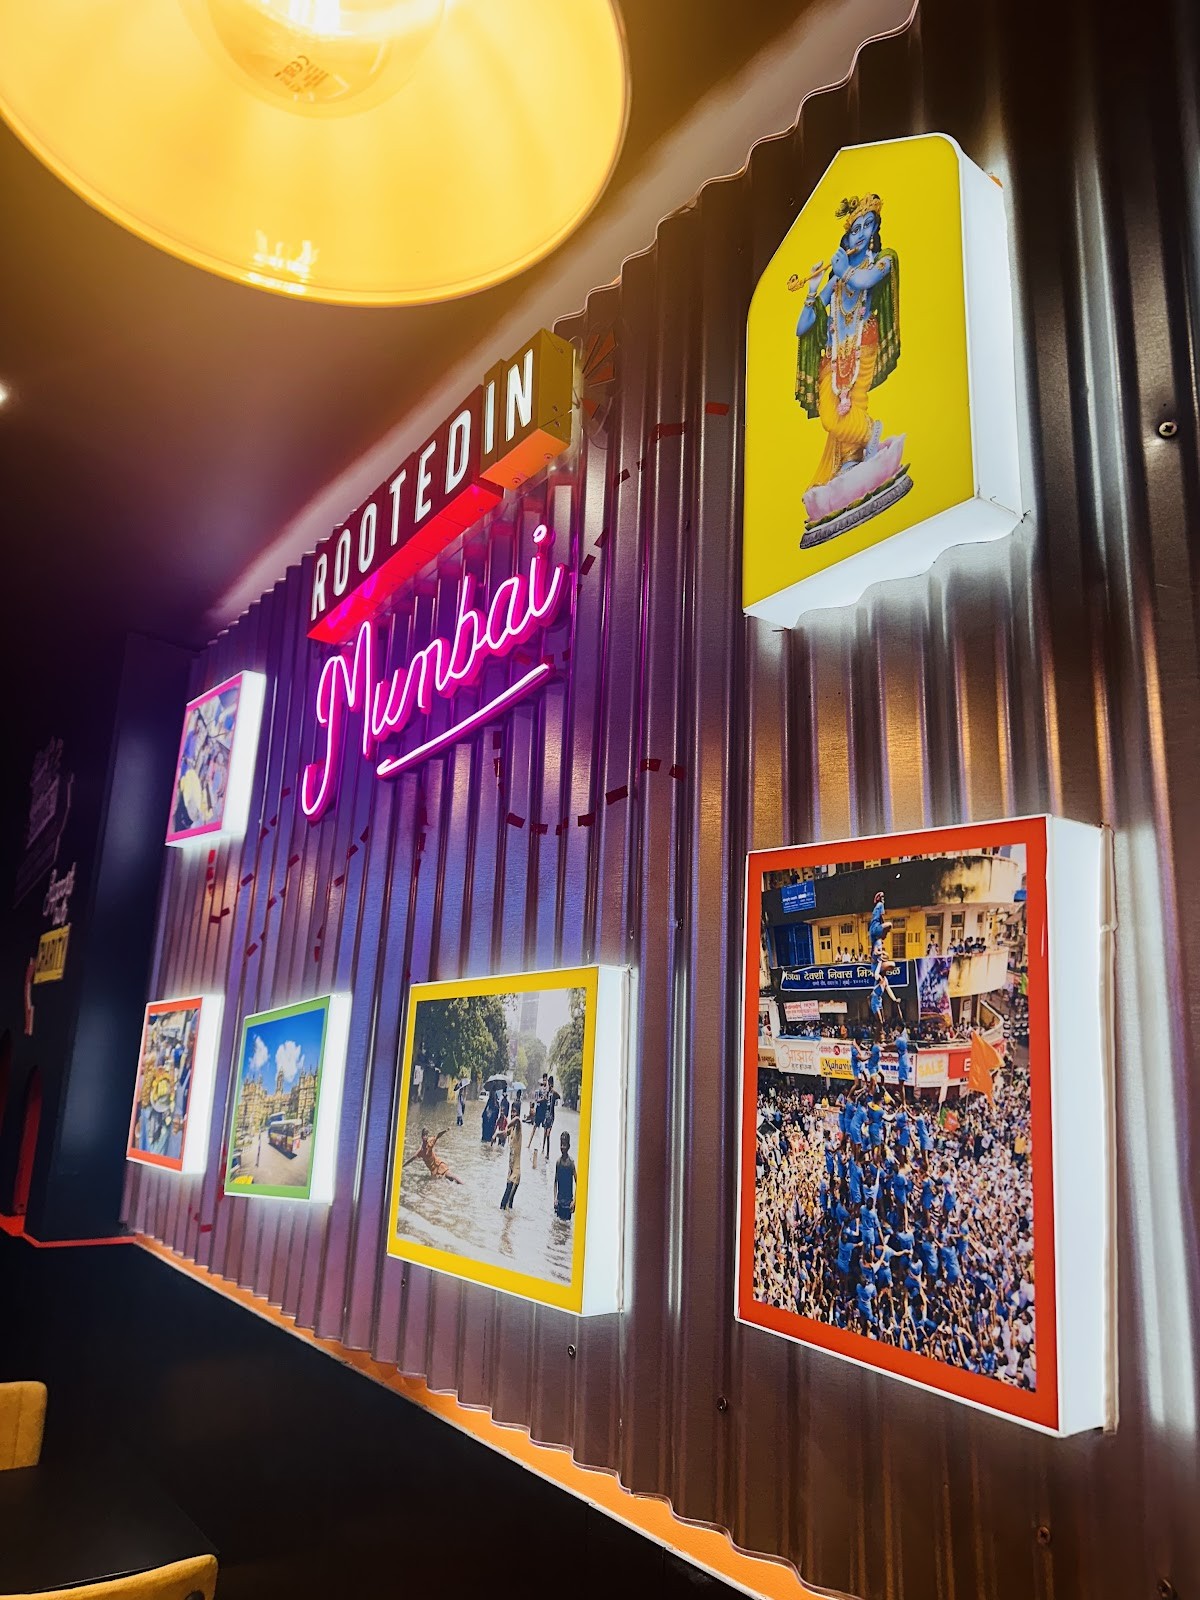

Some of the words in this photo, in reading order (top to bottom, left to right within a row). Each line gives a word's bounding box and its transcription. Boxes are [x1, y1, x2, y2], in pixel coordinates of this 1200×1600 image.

[310, 409, 471, 622] ROOTED
[483, 348, 534, 454] IN
[302, 524, 562, 817] Mumbai
[918, 1059, 944, 1077] SALE
